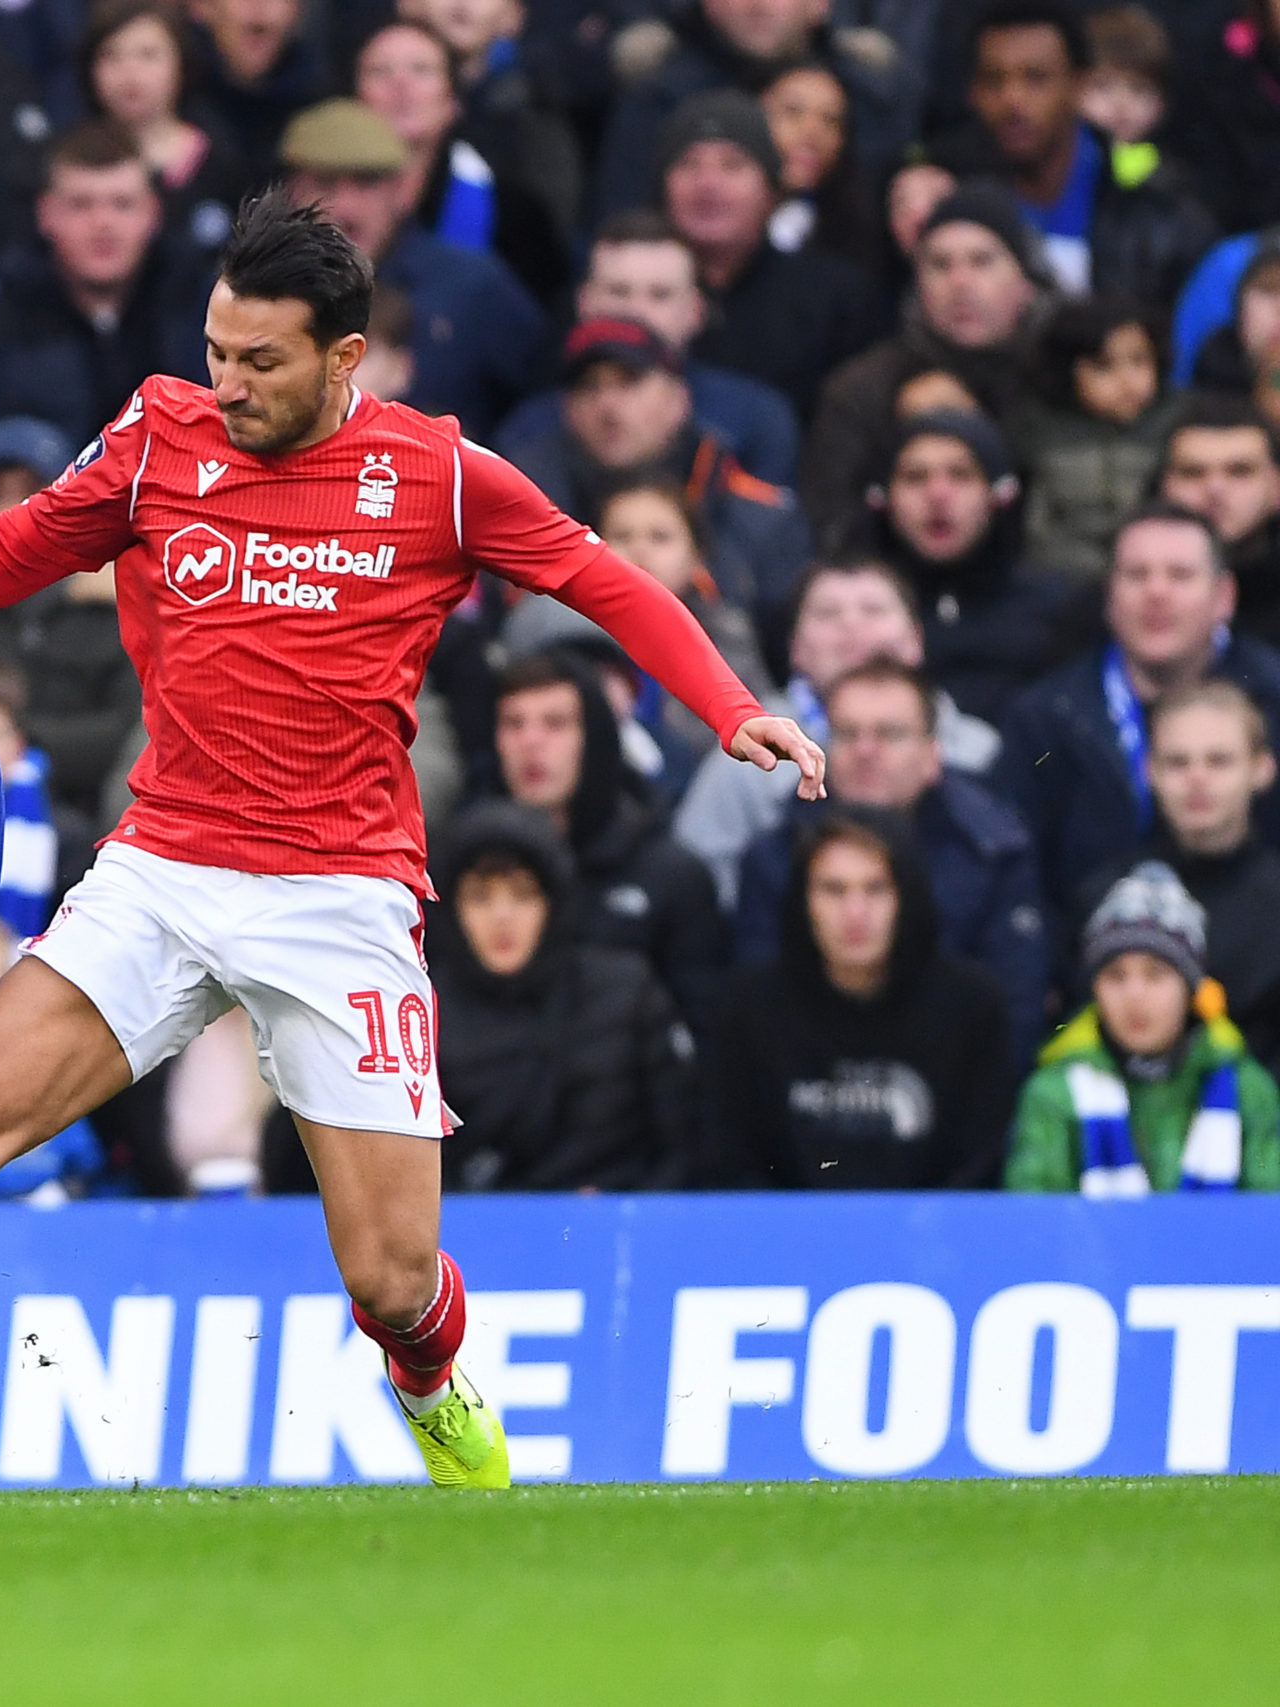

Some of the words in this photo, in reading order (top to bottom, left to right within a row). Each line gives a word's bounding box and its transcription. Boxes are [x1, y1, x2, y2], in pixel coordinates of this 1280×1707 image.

[244, 532, 397, 578] Football
[241, 569, 338, 611] Index
[348, 990, 431, 1076] 10
[660, 1281, 1280, 1476] FOOT
